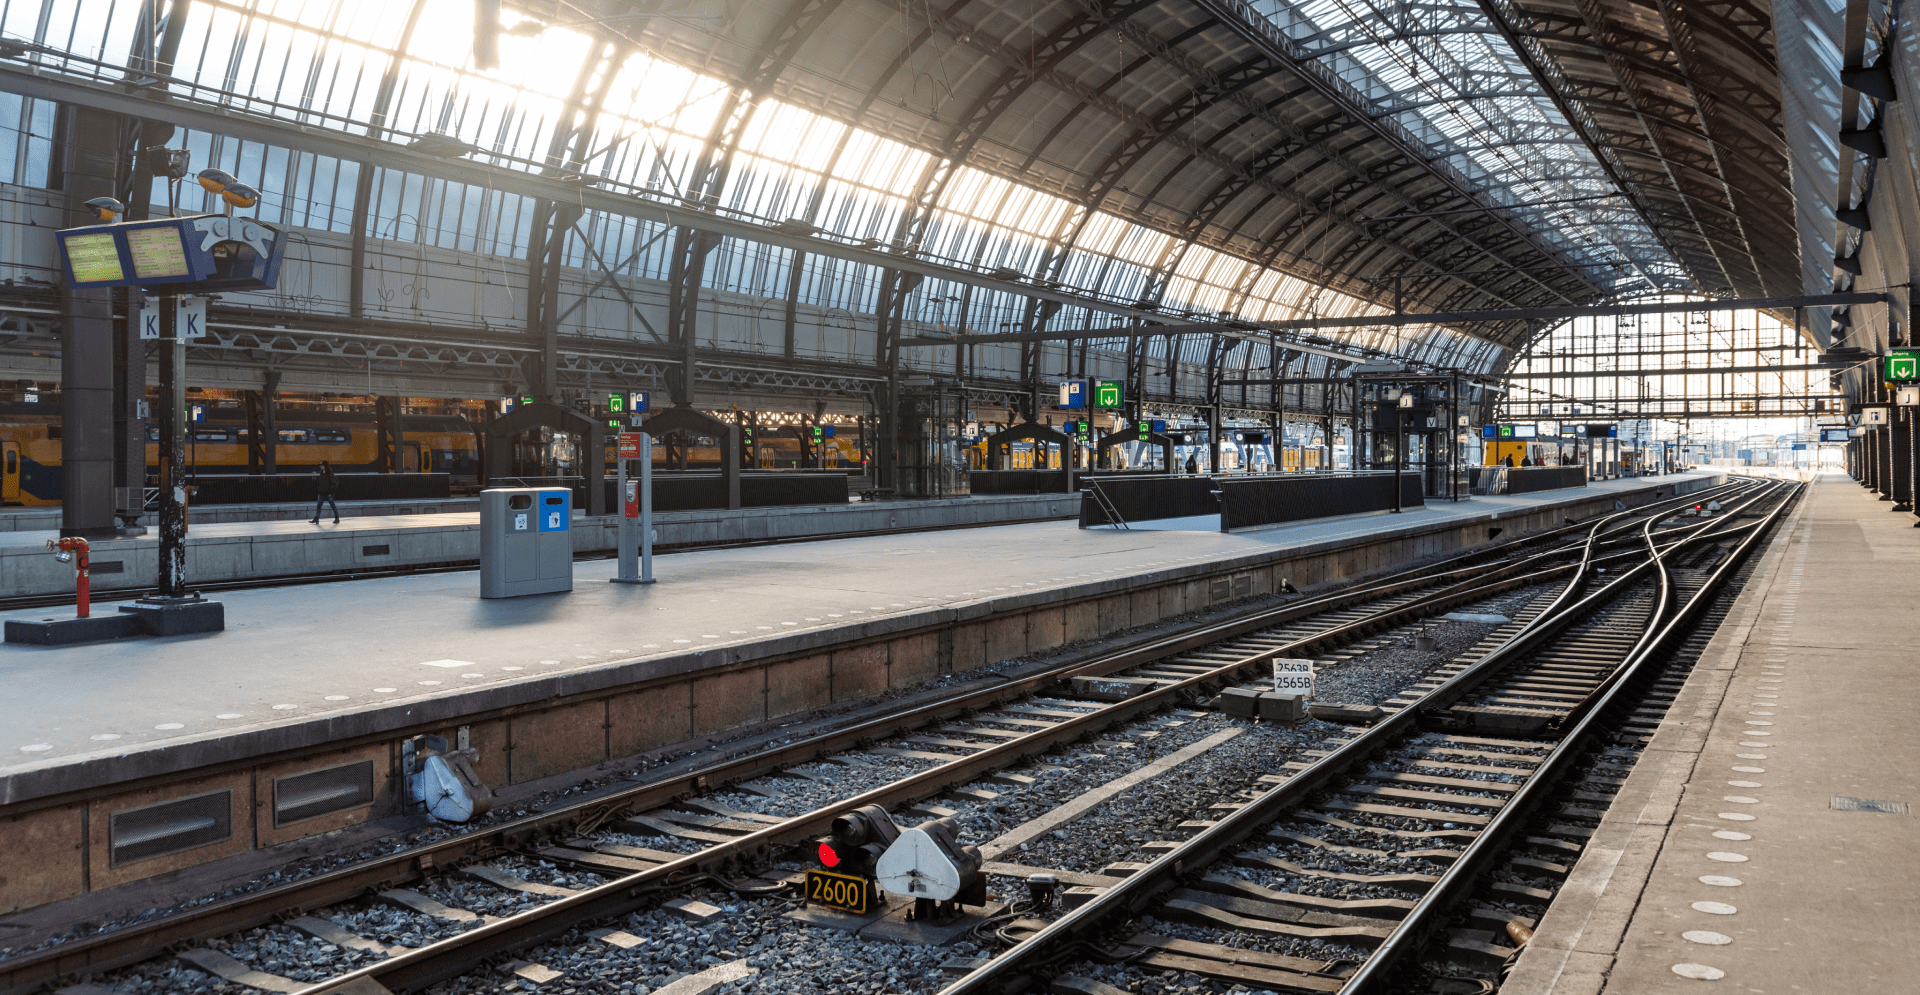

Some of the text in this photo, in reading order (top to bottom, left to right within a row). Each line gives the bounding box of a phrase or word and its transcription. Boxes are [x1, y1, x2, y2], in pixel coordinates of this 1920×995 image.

[147, 315, 157, 336] K
[187, 313, 199, 335] K
[1905, 393, 1911, 404] J
[1427, 418, 1436, 427] V
[1851, 414, 1861, 426] V
[1278, 663, 1309, 672] 2563B
[1276, 677, 1311, 689] 2565B
[812, 876, 859, 907] 2600
